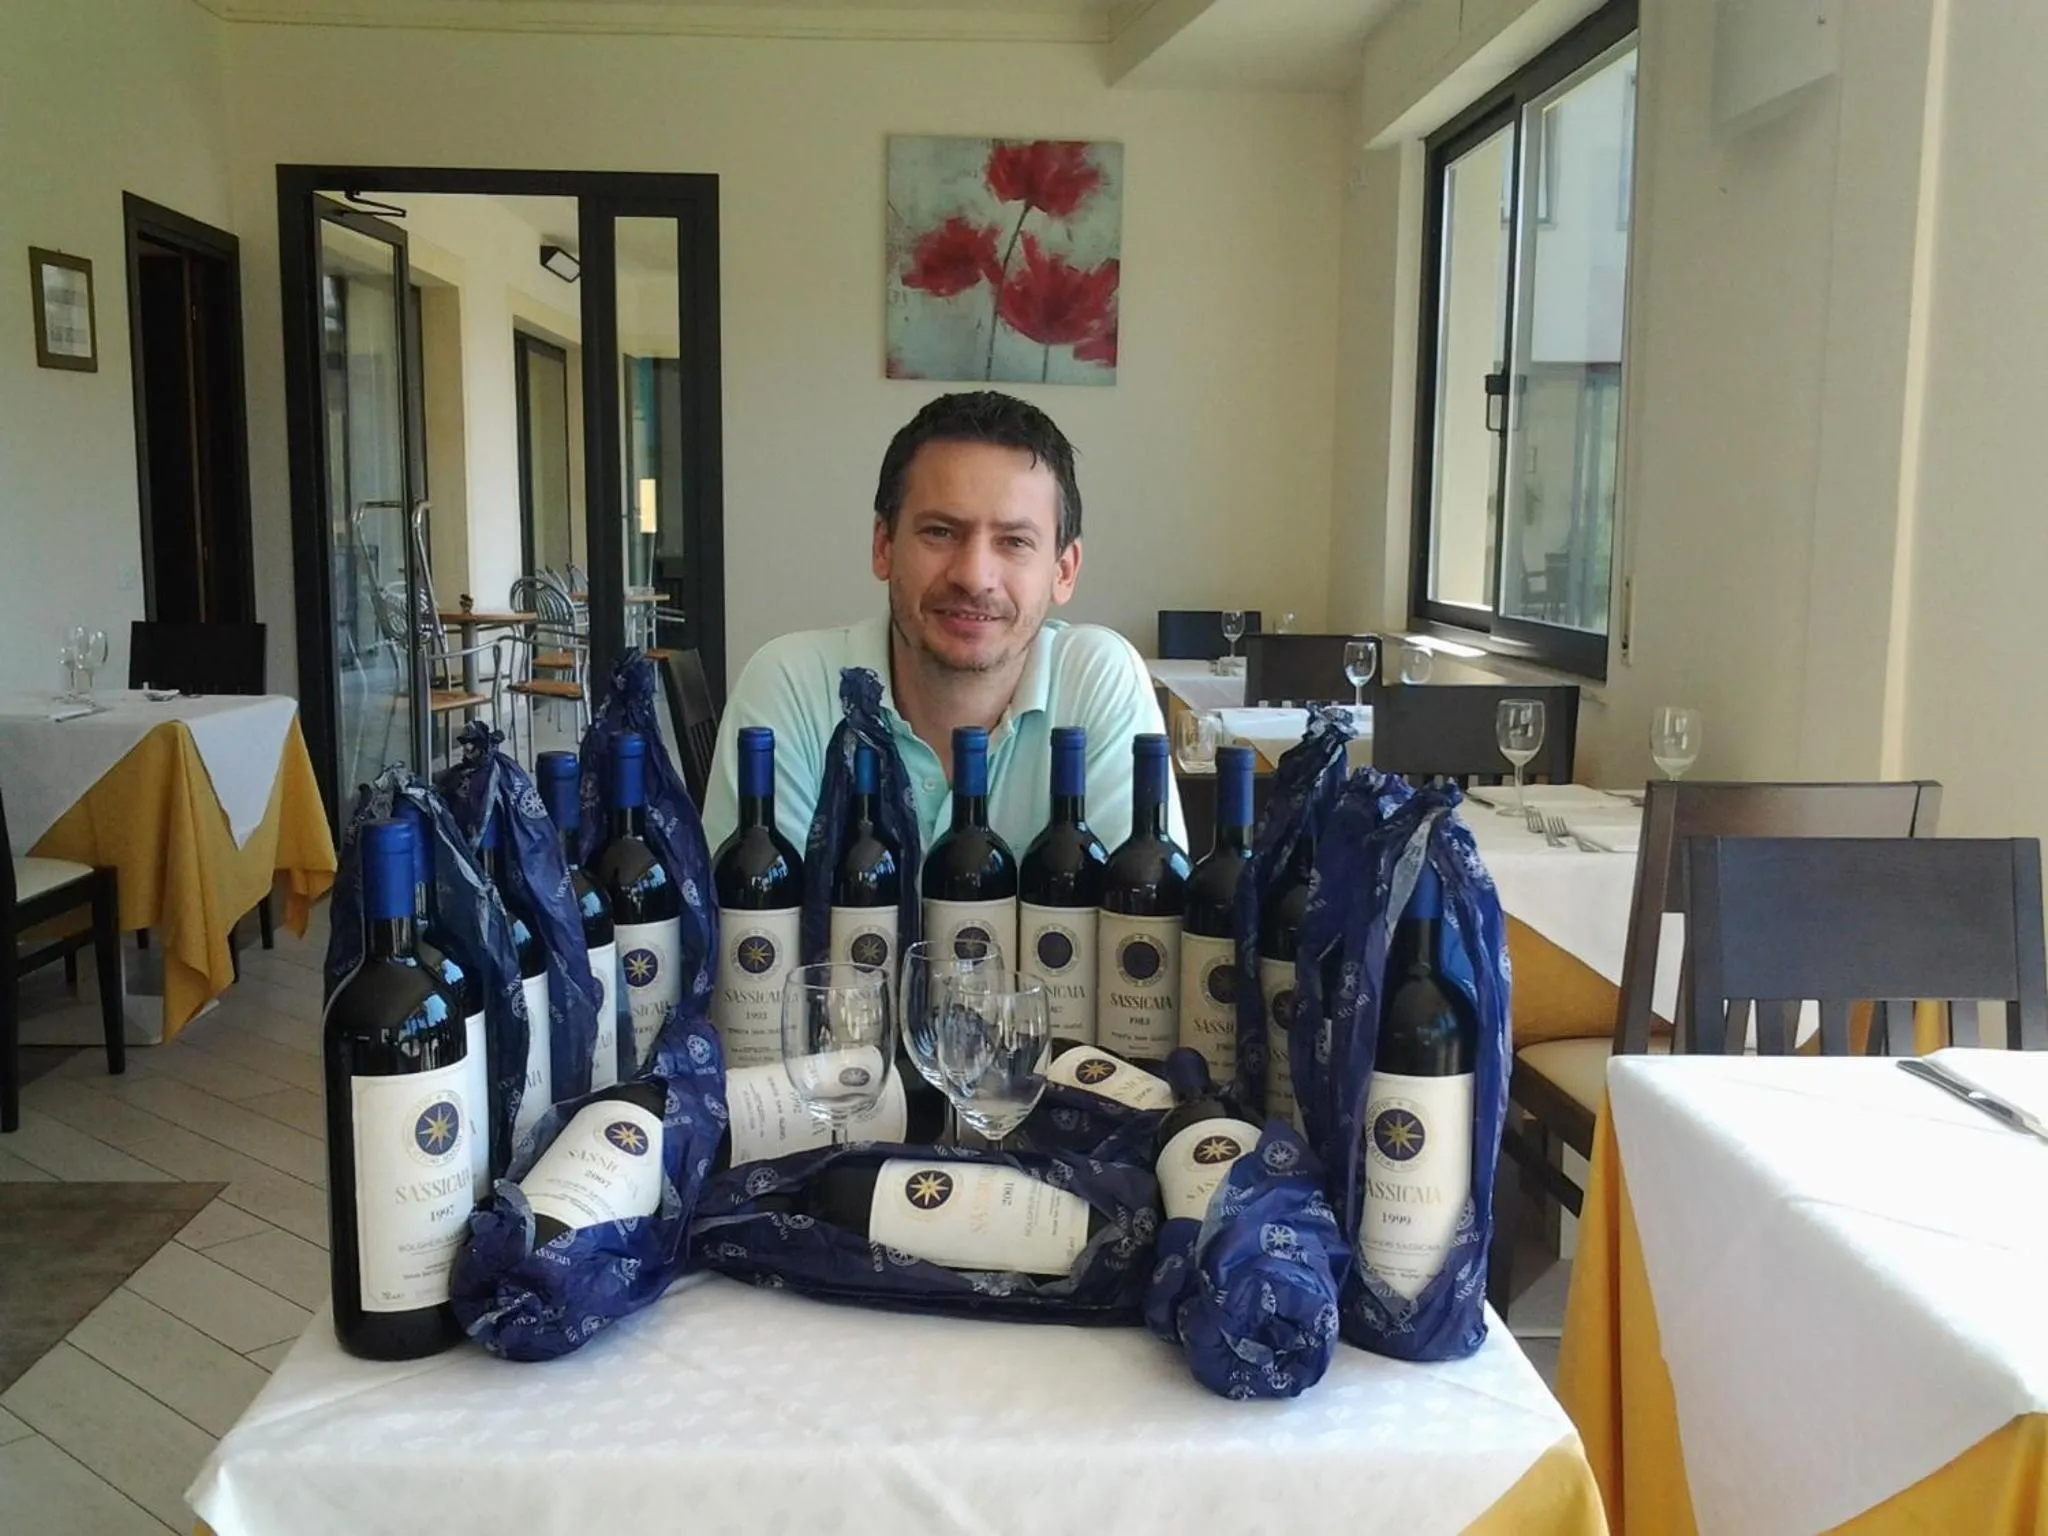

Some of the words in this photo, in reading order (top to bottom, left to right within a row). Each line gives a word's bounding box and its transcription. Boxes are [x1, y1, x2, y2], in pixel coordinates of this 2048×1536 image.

[1110, 991, 1172, 1009] SASSICAIA
[1366, 1176, 1442, 1204] ASSICAIA
[430, 1204, 454, 1222] 1997
[1381, 1212, 1412, 1226] 1999
